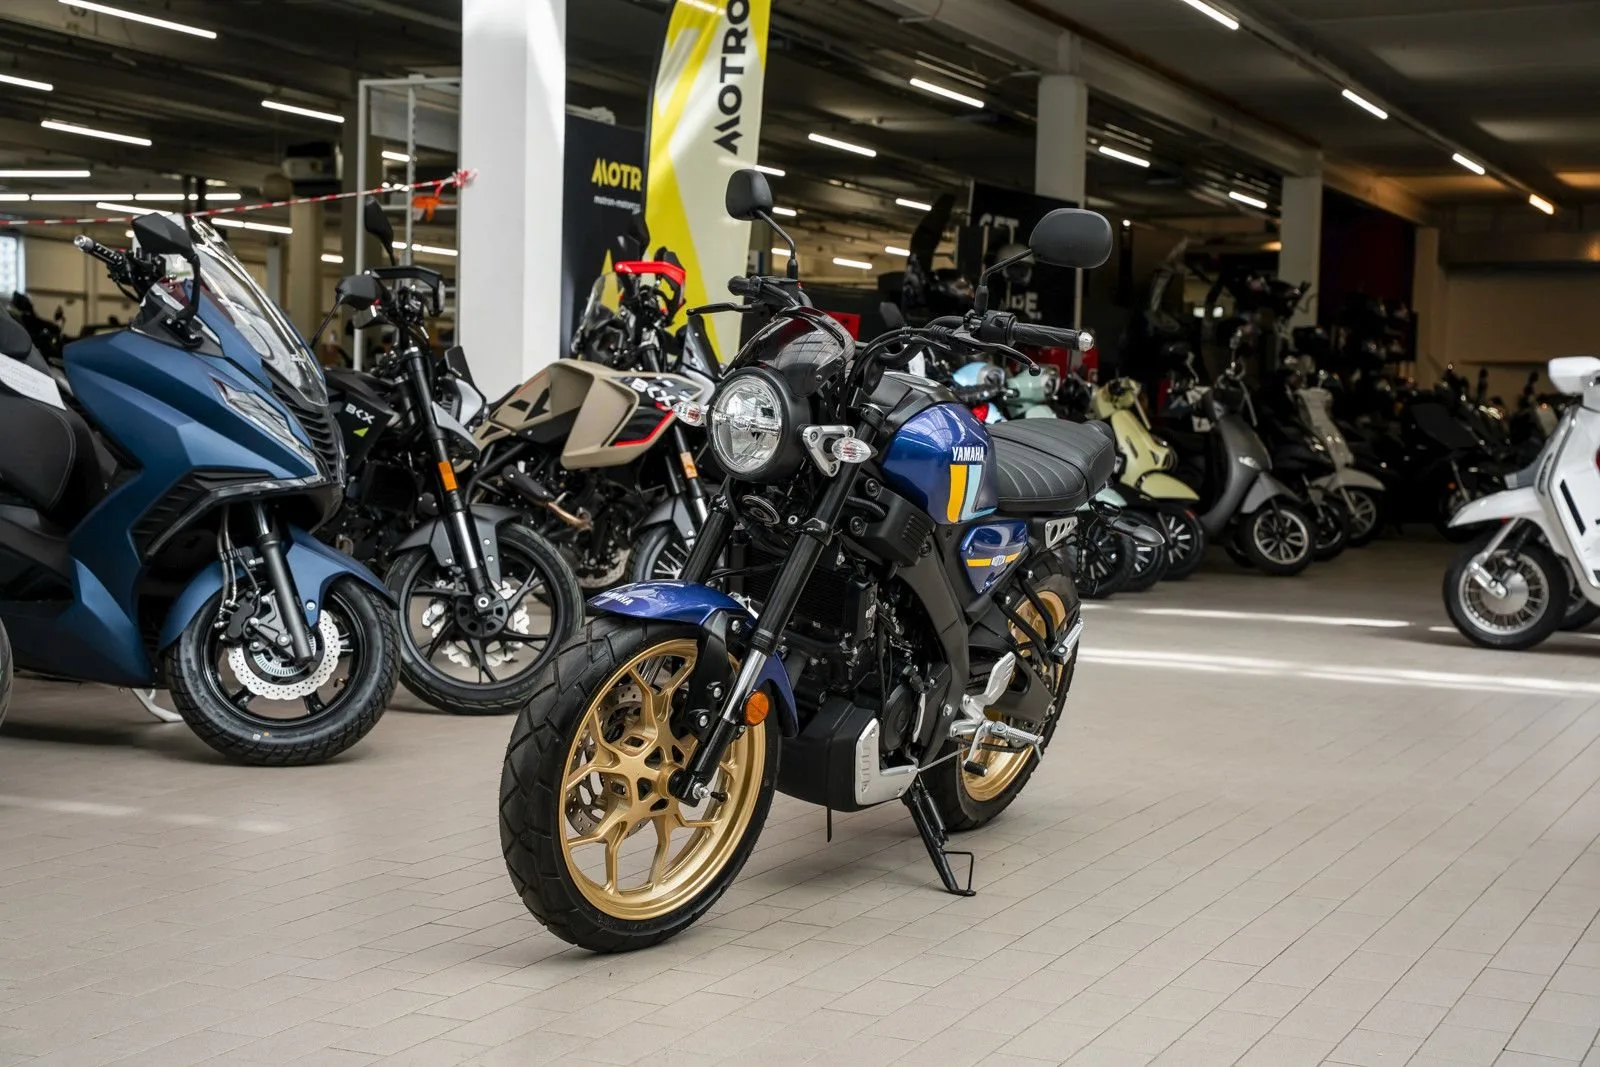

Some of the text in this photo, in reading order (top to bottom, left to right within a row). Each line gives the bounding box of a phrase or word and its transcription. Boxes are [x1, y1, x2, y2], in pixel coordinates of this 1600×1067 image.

[713, 0, 750, 156] MOTRO
[591, 157, 642, 191] MOTR
[951, 446, 985, 462] YAMAHA
